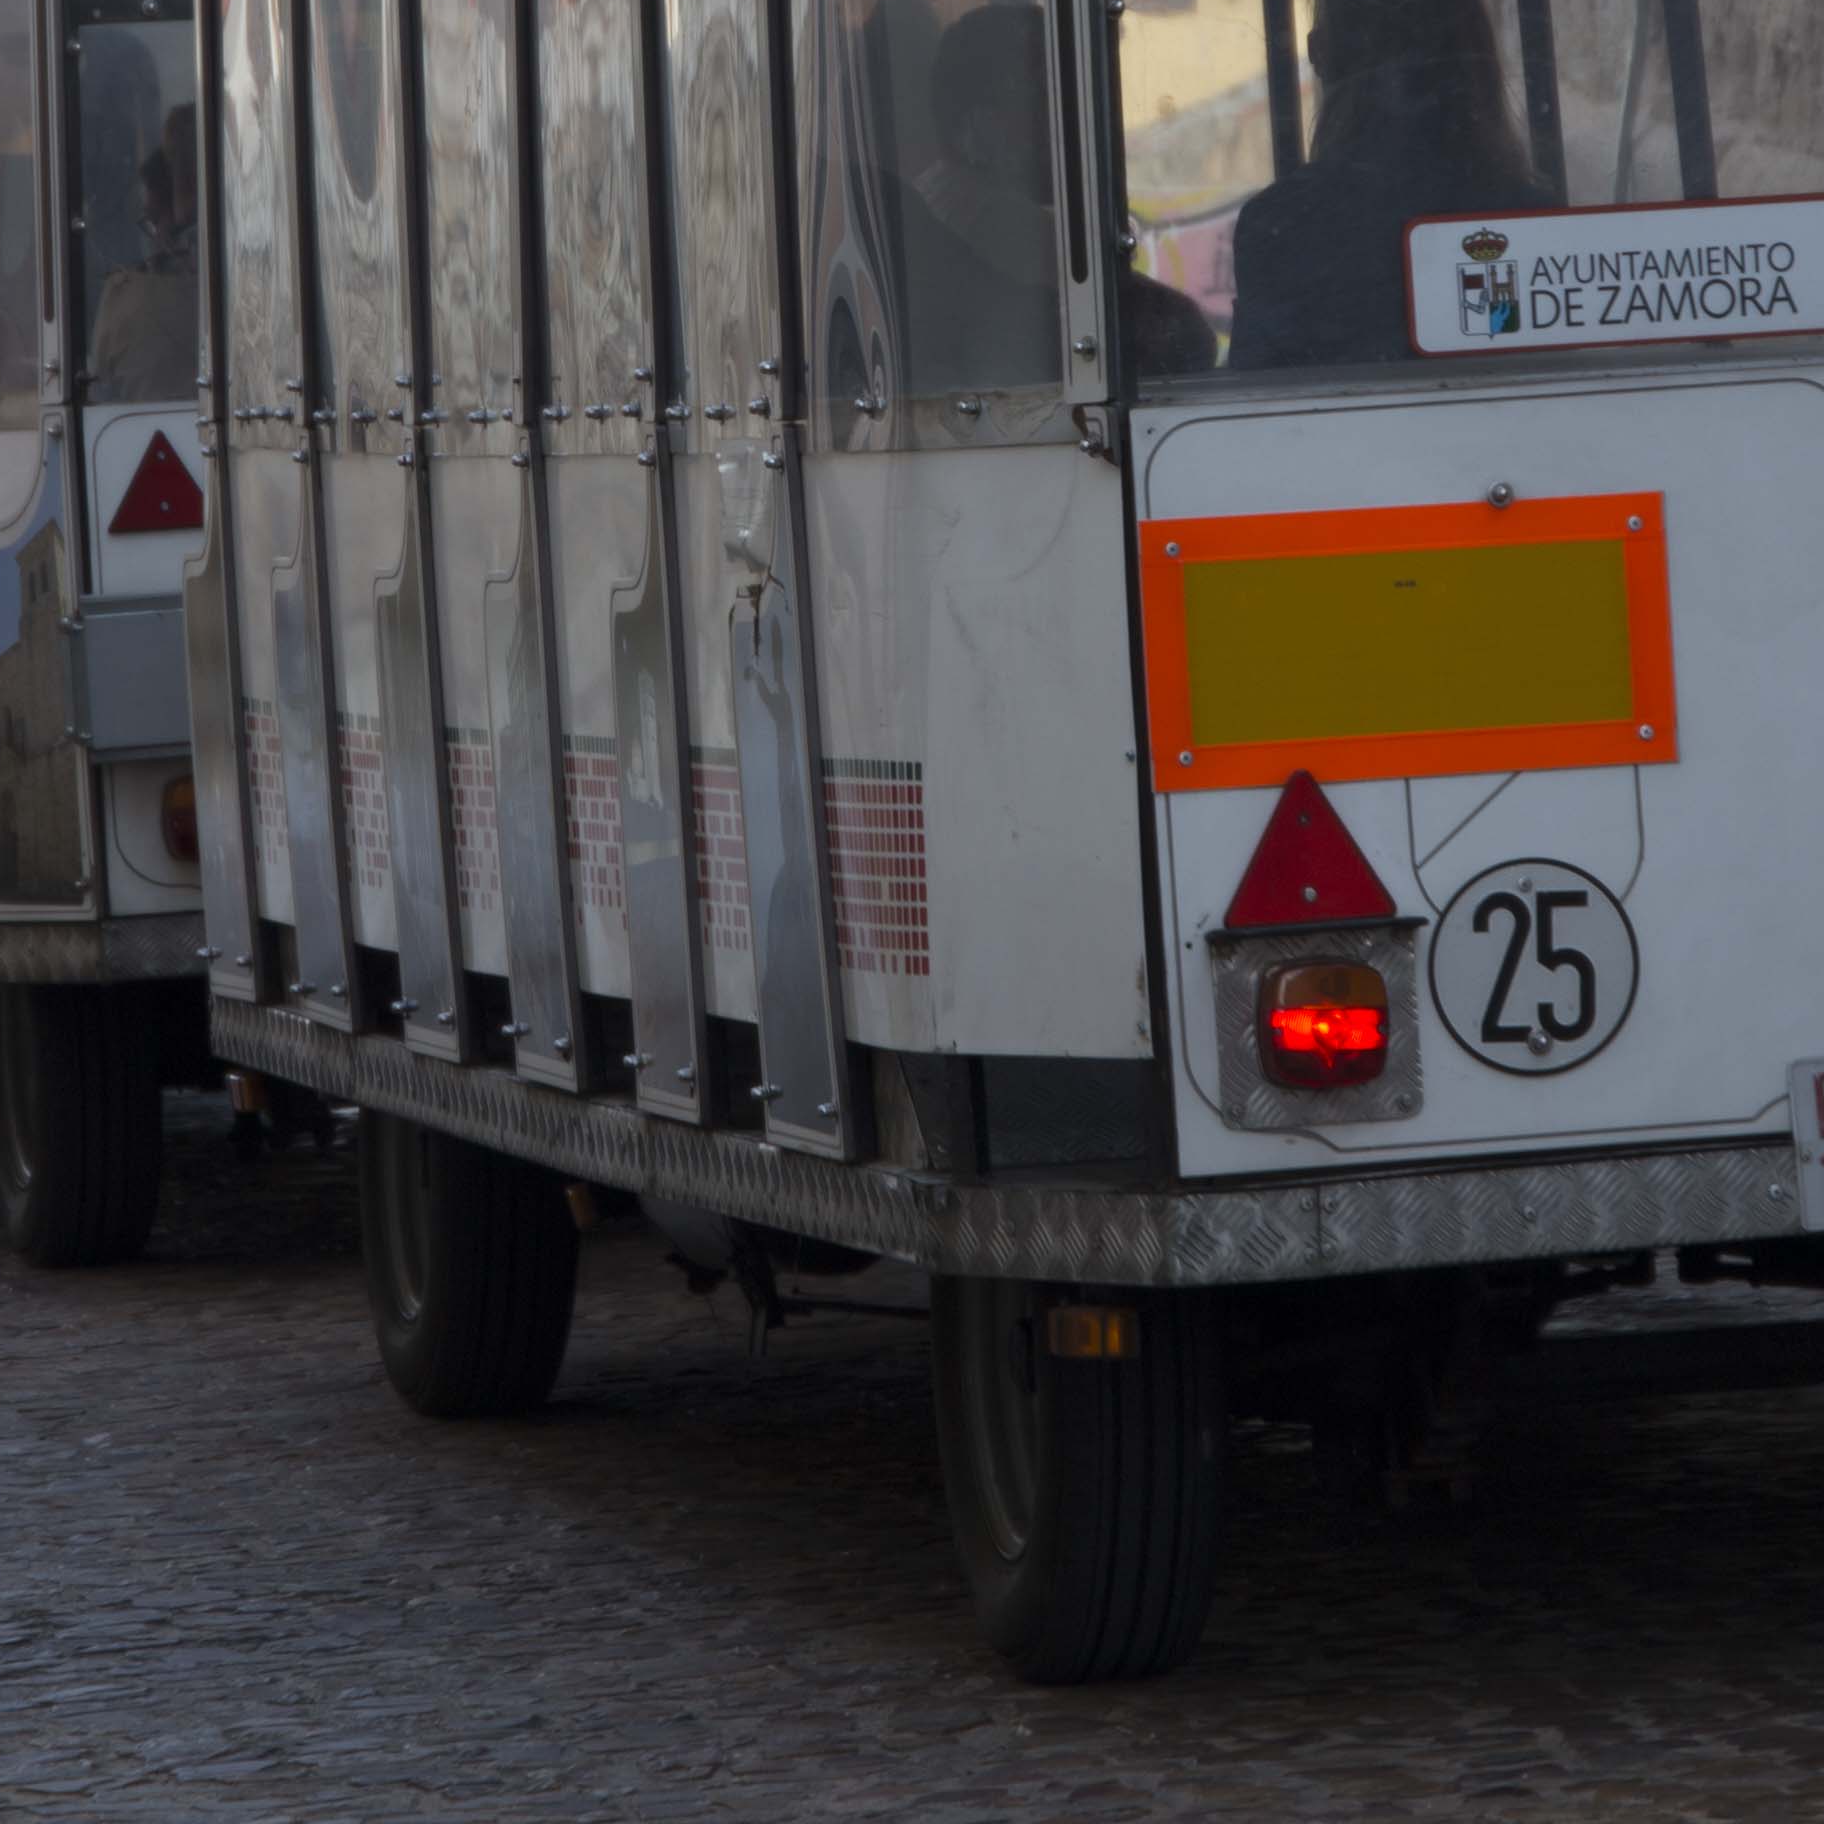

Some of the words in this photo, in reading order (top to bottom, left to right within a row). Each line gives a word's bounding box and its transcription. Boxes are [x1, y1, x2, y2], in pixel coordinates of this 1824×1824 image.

[1530, 241, 1796, 288] AYUNTAMIENTO
[1530, 288, 1584, 330] DE
[1601, 275, 1799, 325] ZAMORA
[1472, 890, 1597, 1043] 25
